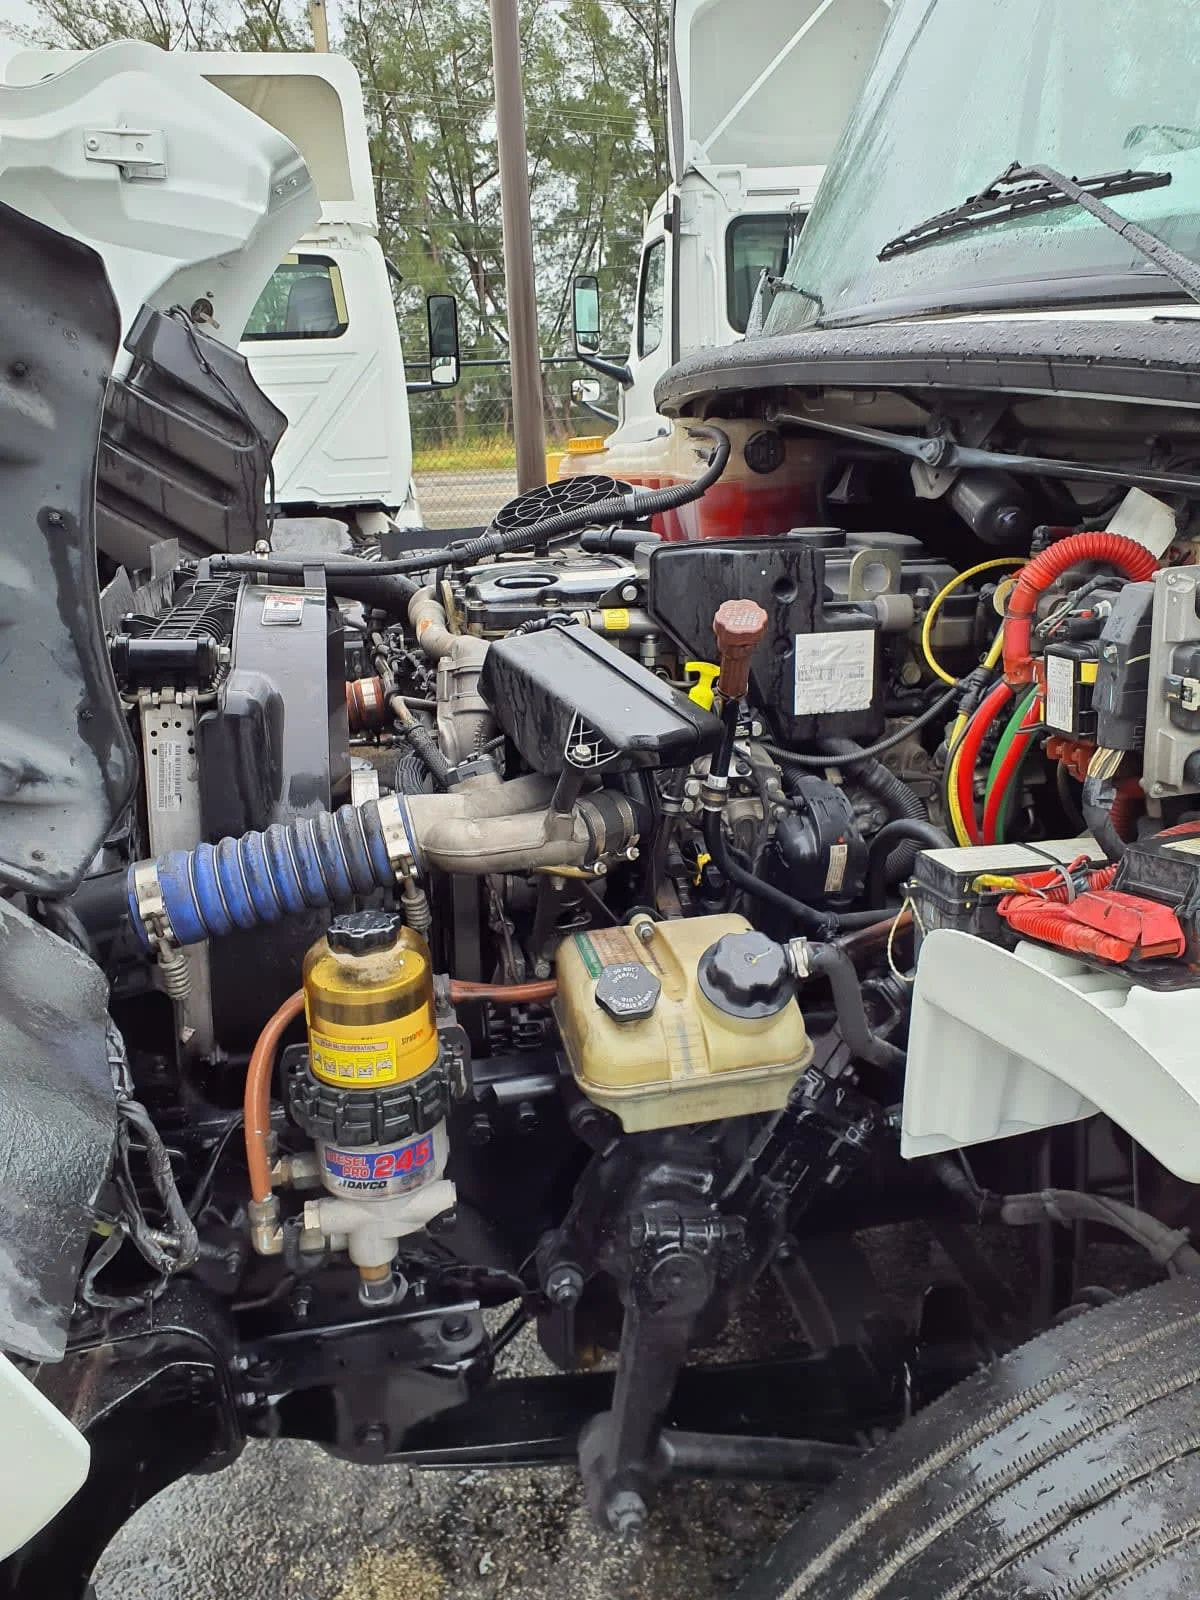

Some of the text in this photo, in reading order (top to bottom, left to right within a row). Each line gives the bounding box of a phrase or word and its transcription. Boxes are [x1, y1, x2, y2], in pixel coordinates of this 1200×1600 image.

[326, 1151, 368, 1167] DIESEL
[373, 1139, 430, 1179] 245
[342, 1166, 370, 1179] PRO
